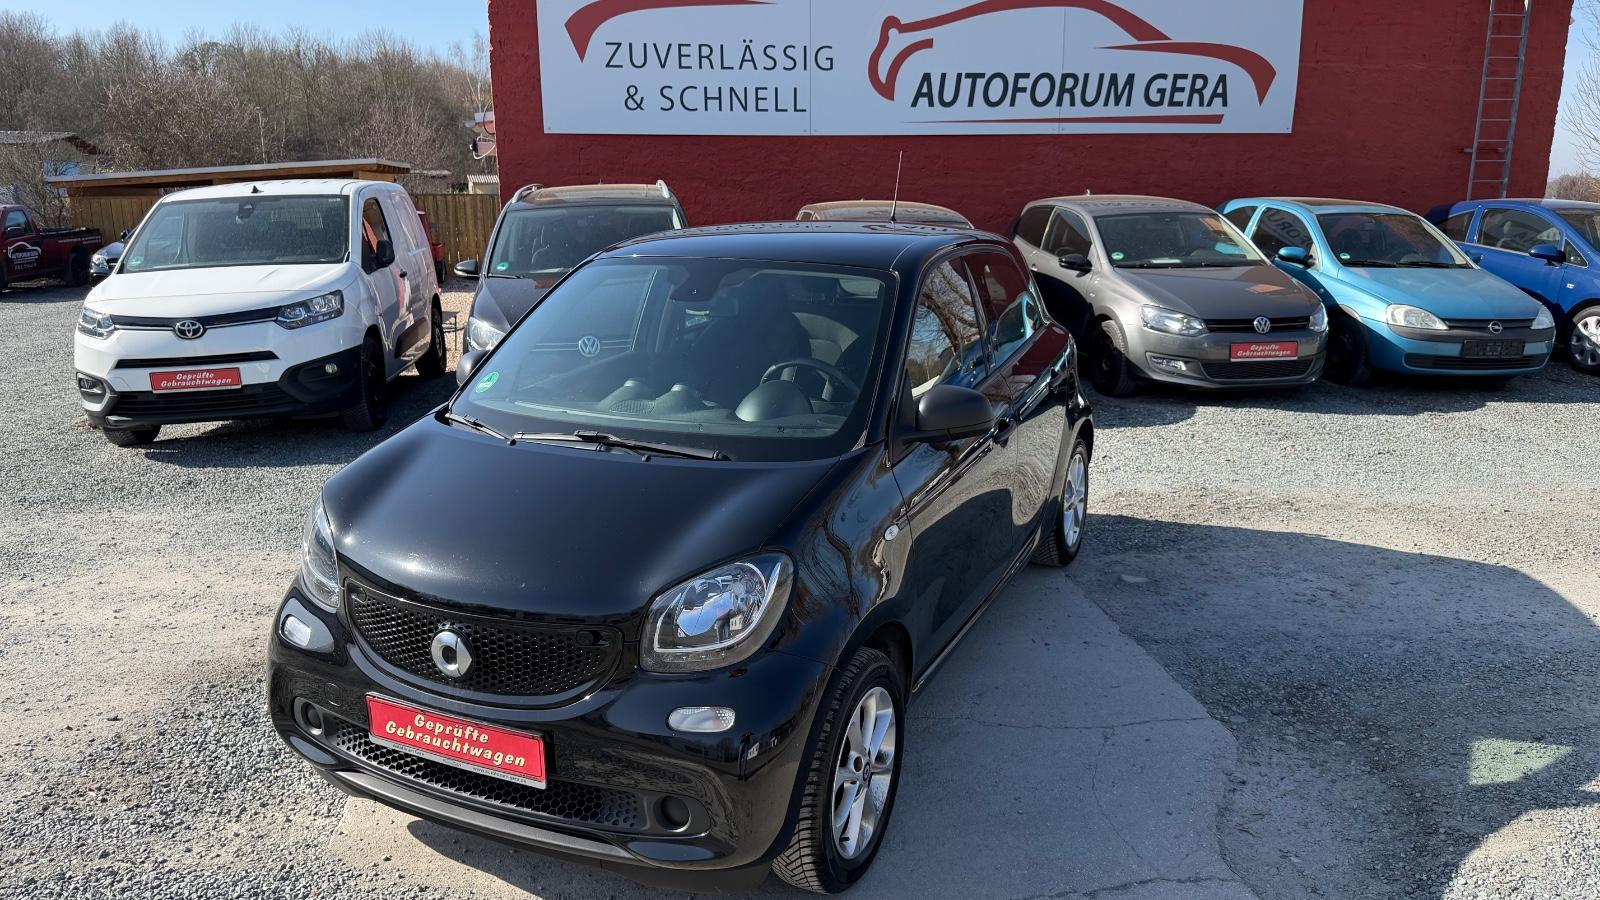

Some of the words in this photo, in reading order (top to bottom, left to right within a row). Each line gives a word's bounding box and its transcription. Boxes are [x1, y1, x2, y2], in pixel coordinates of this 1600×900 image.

[605, 39, 834, 71] ZUVERLÄSSIG
[624, 84, 645, 111] &
[659, 85, 807, 112] SCHNELL
[910, 72, 1136, 108] AUTOFORUM
[1143, 73, 1228, 108] GERA
[160, 378, 232, 387] Gebrauchtwagen
[176, 371, 214, 380] Geprüfte
[414, 714, 489, 743] Geprüfte
[385, 720, 525, 767] Gebrauchtwagen
